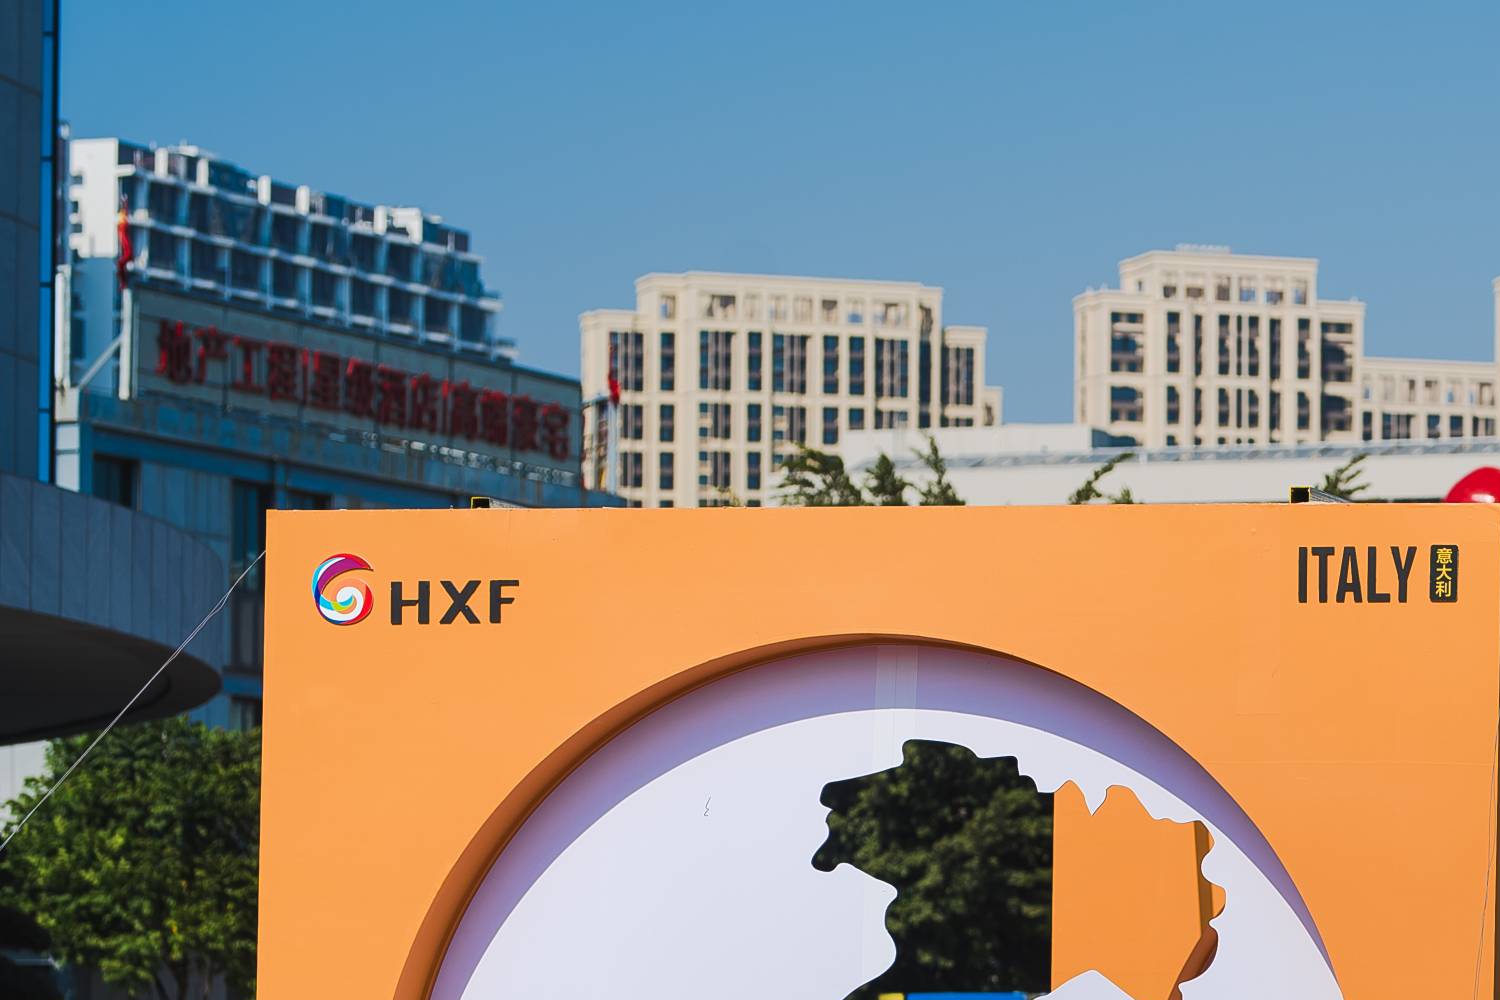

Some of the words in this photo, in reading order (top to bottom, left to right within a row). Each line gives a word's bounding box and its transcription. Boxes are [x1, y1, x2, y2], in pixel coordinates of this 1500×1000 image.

[1298, 546, 1418, 603] ITALY
[1435, 547, 1454, 599] 意大利
[390, 580, 520, 626] HXF
